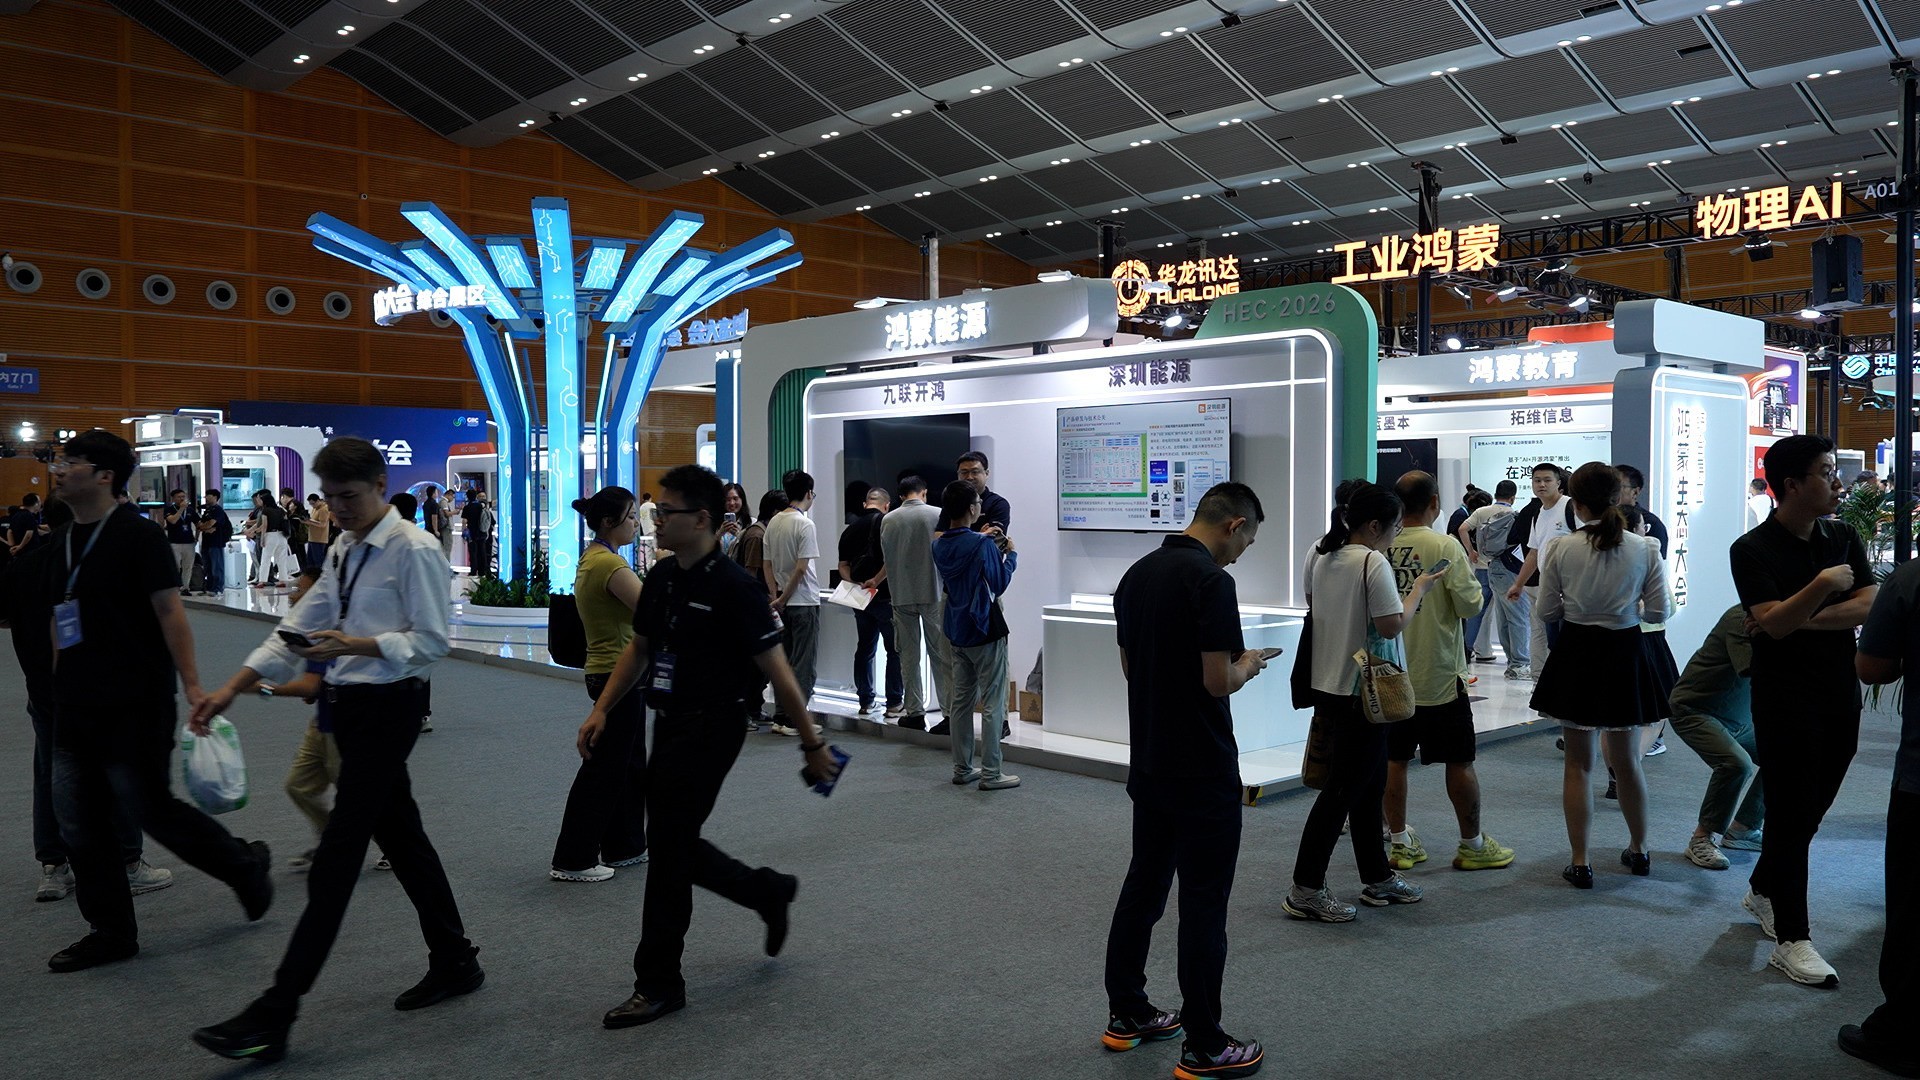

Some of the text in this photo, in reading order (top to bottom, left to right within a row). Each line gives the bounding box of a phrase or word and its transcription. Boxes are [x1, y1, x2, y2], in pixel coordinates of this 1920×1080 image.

[1864, 181, 1899, 200] A01
[1696, 181, 1843, 240] 物理AI
[1331, 223, 1501, 285] 工业鸿蒙
[1157, 254, 1240, 287] 华龙讯达
[1156, 281, 1240, 305] HUALONG
[885, 301, 988, 351] 鸿蒙能源
[1108, 358, 1192, 388] 深圳能源
[1468, 350, 1578, 384] 鸿蒙教育
[883, 380, 946, 405] 九联开鸿
[1510, 406, 1574, 426] 拓维信息
